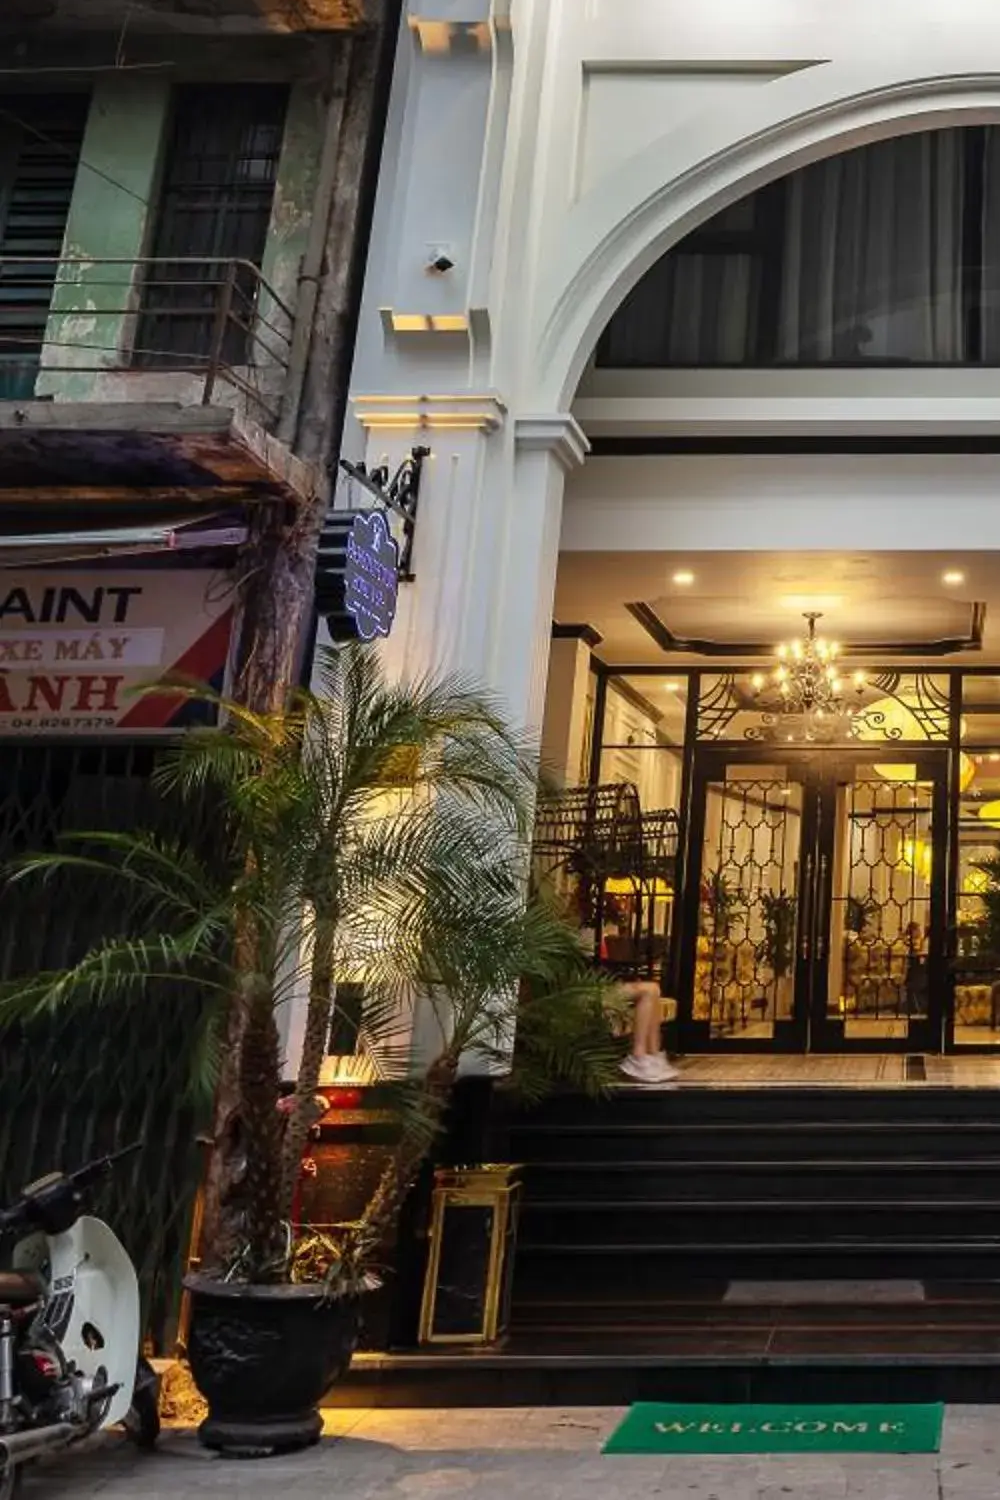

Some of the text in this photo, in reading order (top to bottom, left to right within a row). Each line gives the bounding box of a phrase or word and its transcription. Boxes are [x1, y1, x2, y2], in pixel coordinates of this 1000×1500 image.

[0, 587, 142, 622] AINT
[54, 631, 131, 661] MÁY
[654, 1421, 904, 1434] WELCOME
